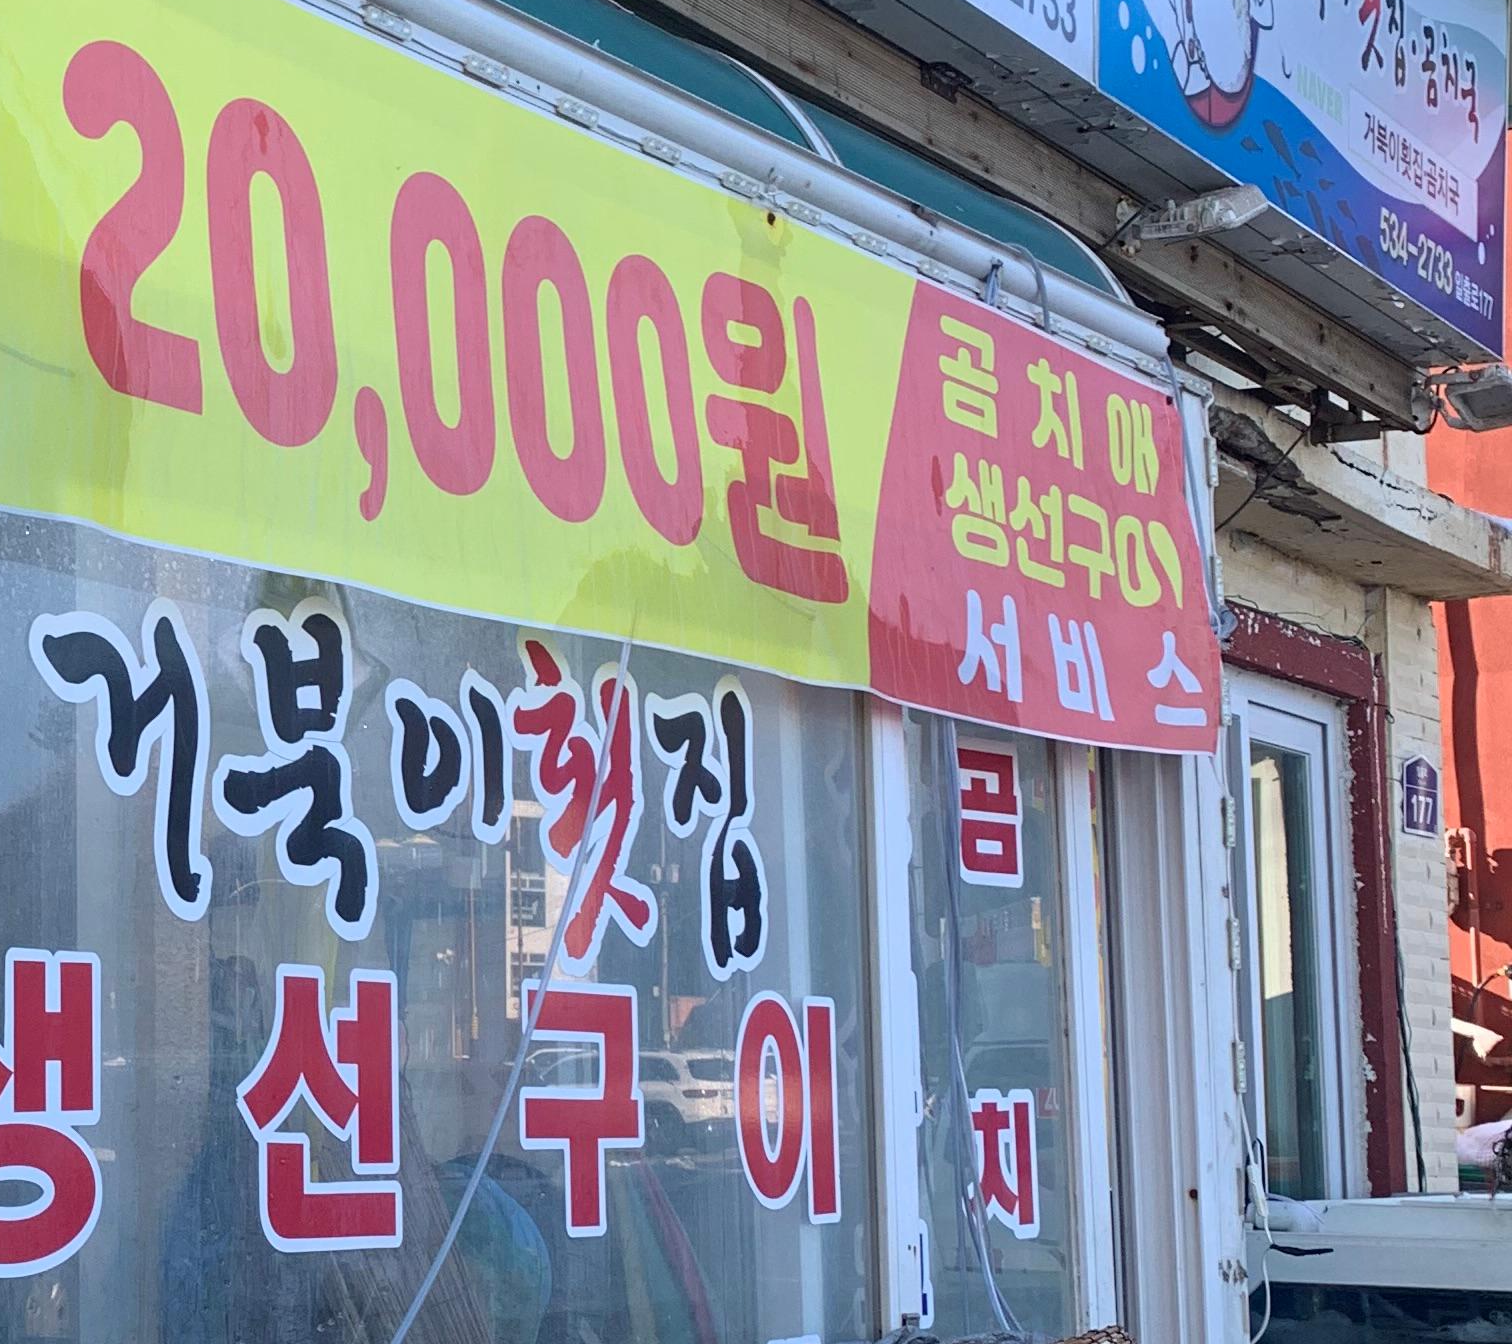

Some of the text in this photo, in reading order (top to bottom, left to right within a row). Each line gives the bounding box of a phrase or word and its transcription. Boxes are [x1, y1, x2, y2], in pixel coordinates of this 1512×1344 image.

[63, 41, 848, 602] 20,000원
[1380, 207, 1454, 294] 534-2733
[945, 452, 1183, 609] 생선구이
[957, 589, 1208, 727] 서비스
[41, 612, 766, 970] 거북이횟집
[1411, 794, 1433, 825] 177
